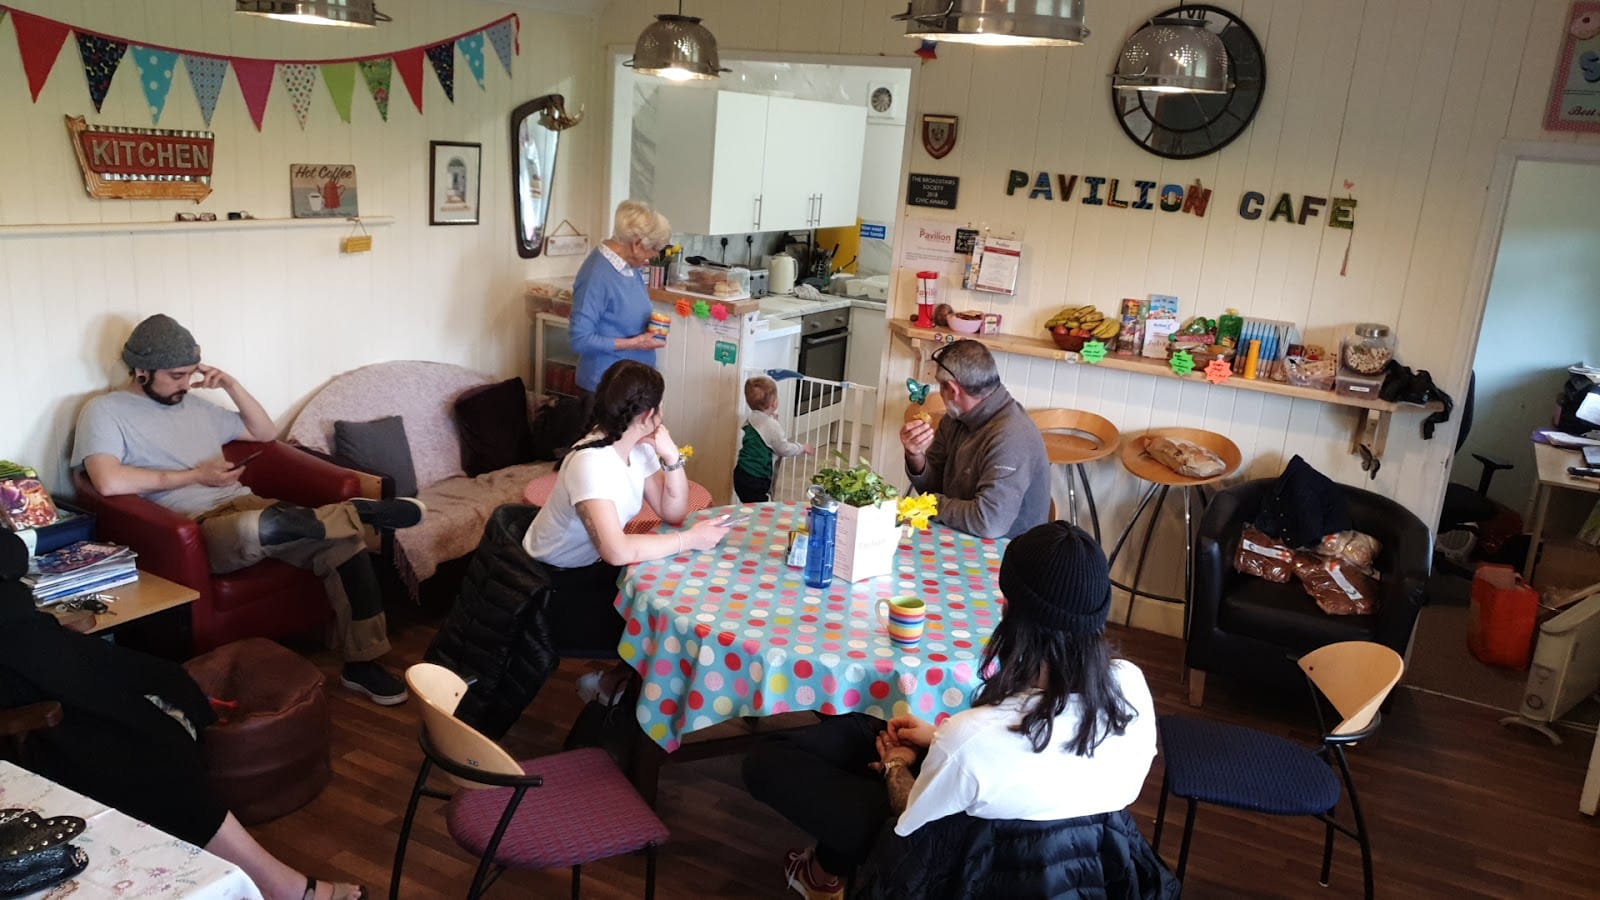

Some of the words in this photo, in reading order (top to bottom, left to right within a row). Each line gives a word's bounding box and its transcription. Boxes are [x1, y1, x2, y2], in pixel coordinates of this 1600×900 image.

[92, 139, 209, 169] KITCHEN
[295, 166, 317, 178] Hot
[318, 166, 353, 180] Coffee
[912, 175, 921, 183] THE
[922, 177, 956, 185] BROADSTAIRS
[1006, 169, 1213, 218] PAVILION
[920, 230, 951, 241] Pavilion
